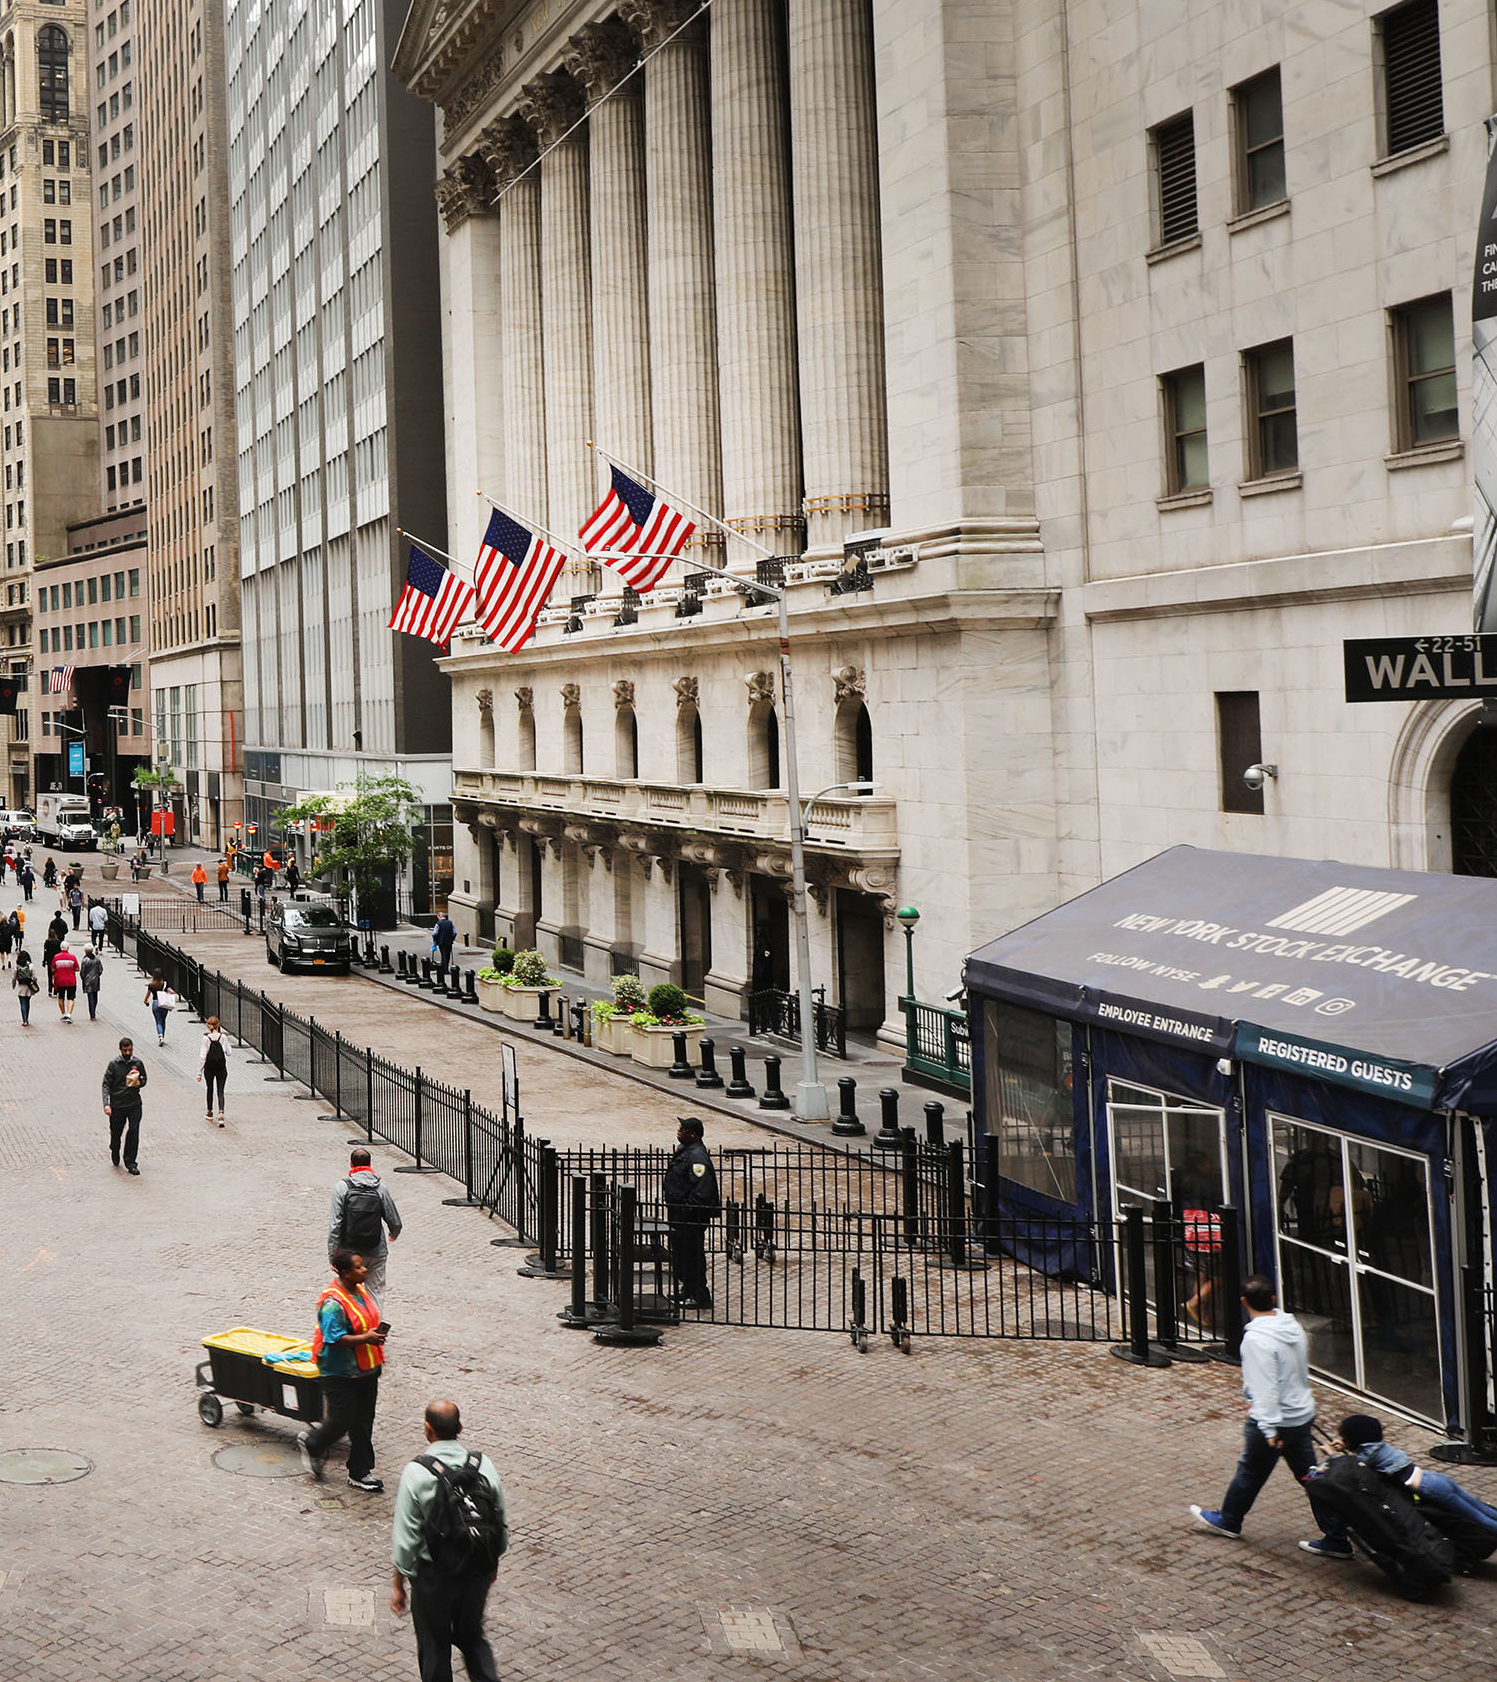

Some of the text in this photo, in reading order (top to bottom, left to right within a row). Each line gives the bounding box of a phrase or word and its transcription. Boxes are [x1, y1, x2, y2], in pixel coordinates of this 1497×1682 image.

[1482, 261, 1497, 275] CA
[1432, 636, 1481, 653] 22-51
[1365, 652, 1497, 690] WALL
[1086, 952, 1157, 972] FOLLOW
[1151, 964, 1202, 983] NYSE
[1113, 913, 1491, 991] NEW YORK STOCK EXCHANGE
[1098, 1003, 1213, 1043] EMPLOYEE ENTRANCE
[1258, 1037, 1413, 1090] REGISTERED GUESTS
